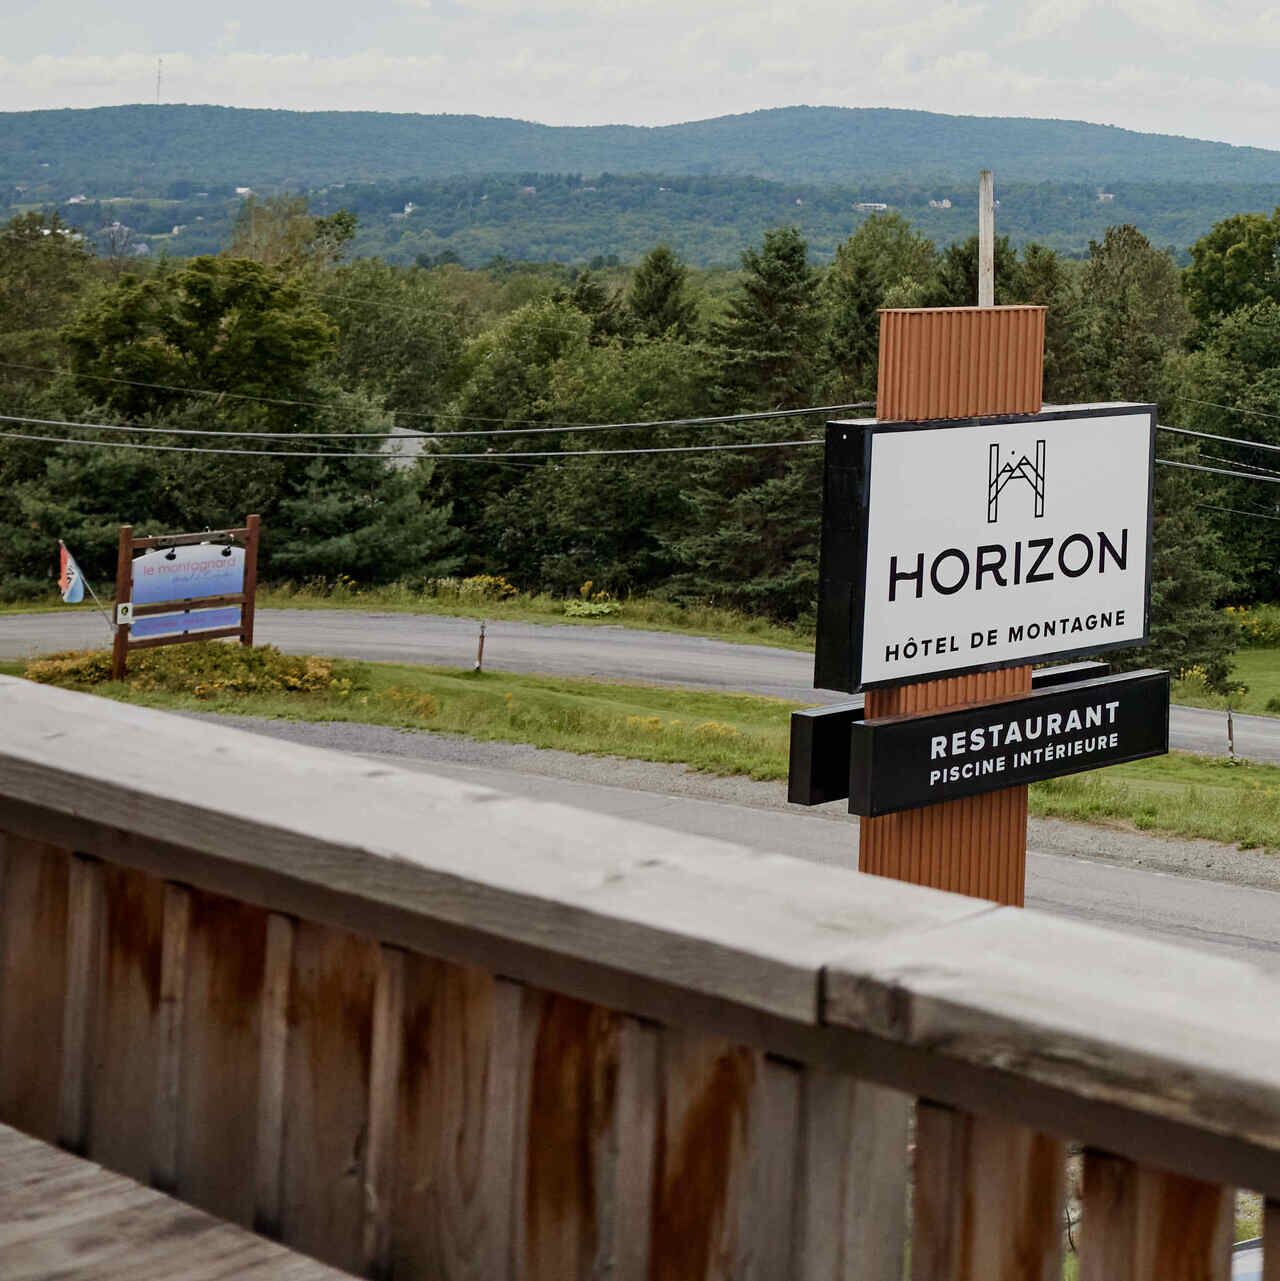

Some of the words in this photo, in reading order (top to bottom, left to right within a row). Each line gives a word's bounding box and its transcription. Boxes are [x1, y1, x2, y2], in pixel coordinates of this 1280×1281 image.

[887, 528, 1129, 602] HORIZON
[885, 635, 960, 662] HÔTEL
[970, 628, 998, 649] DE
[1008, 609, 1126, 644] MONTAGNE
[929, 700, 1121, 760] RESTAURANT
[928, 756, 1007, 787] PISCINE
[1012, 732, 1119, 769] INTÉRIEURE
